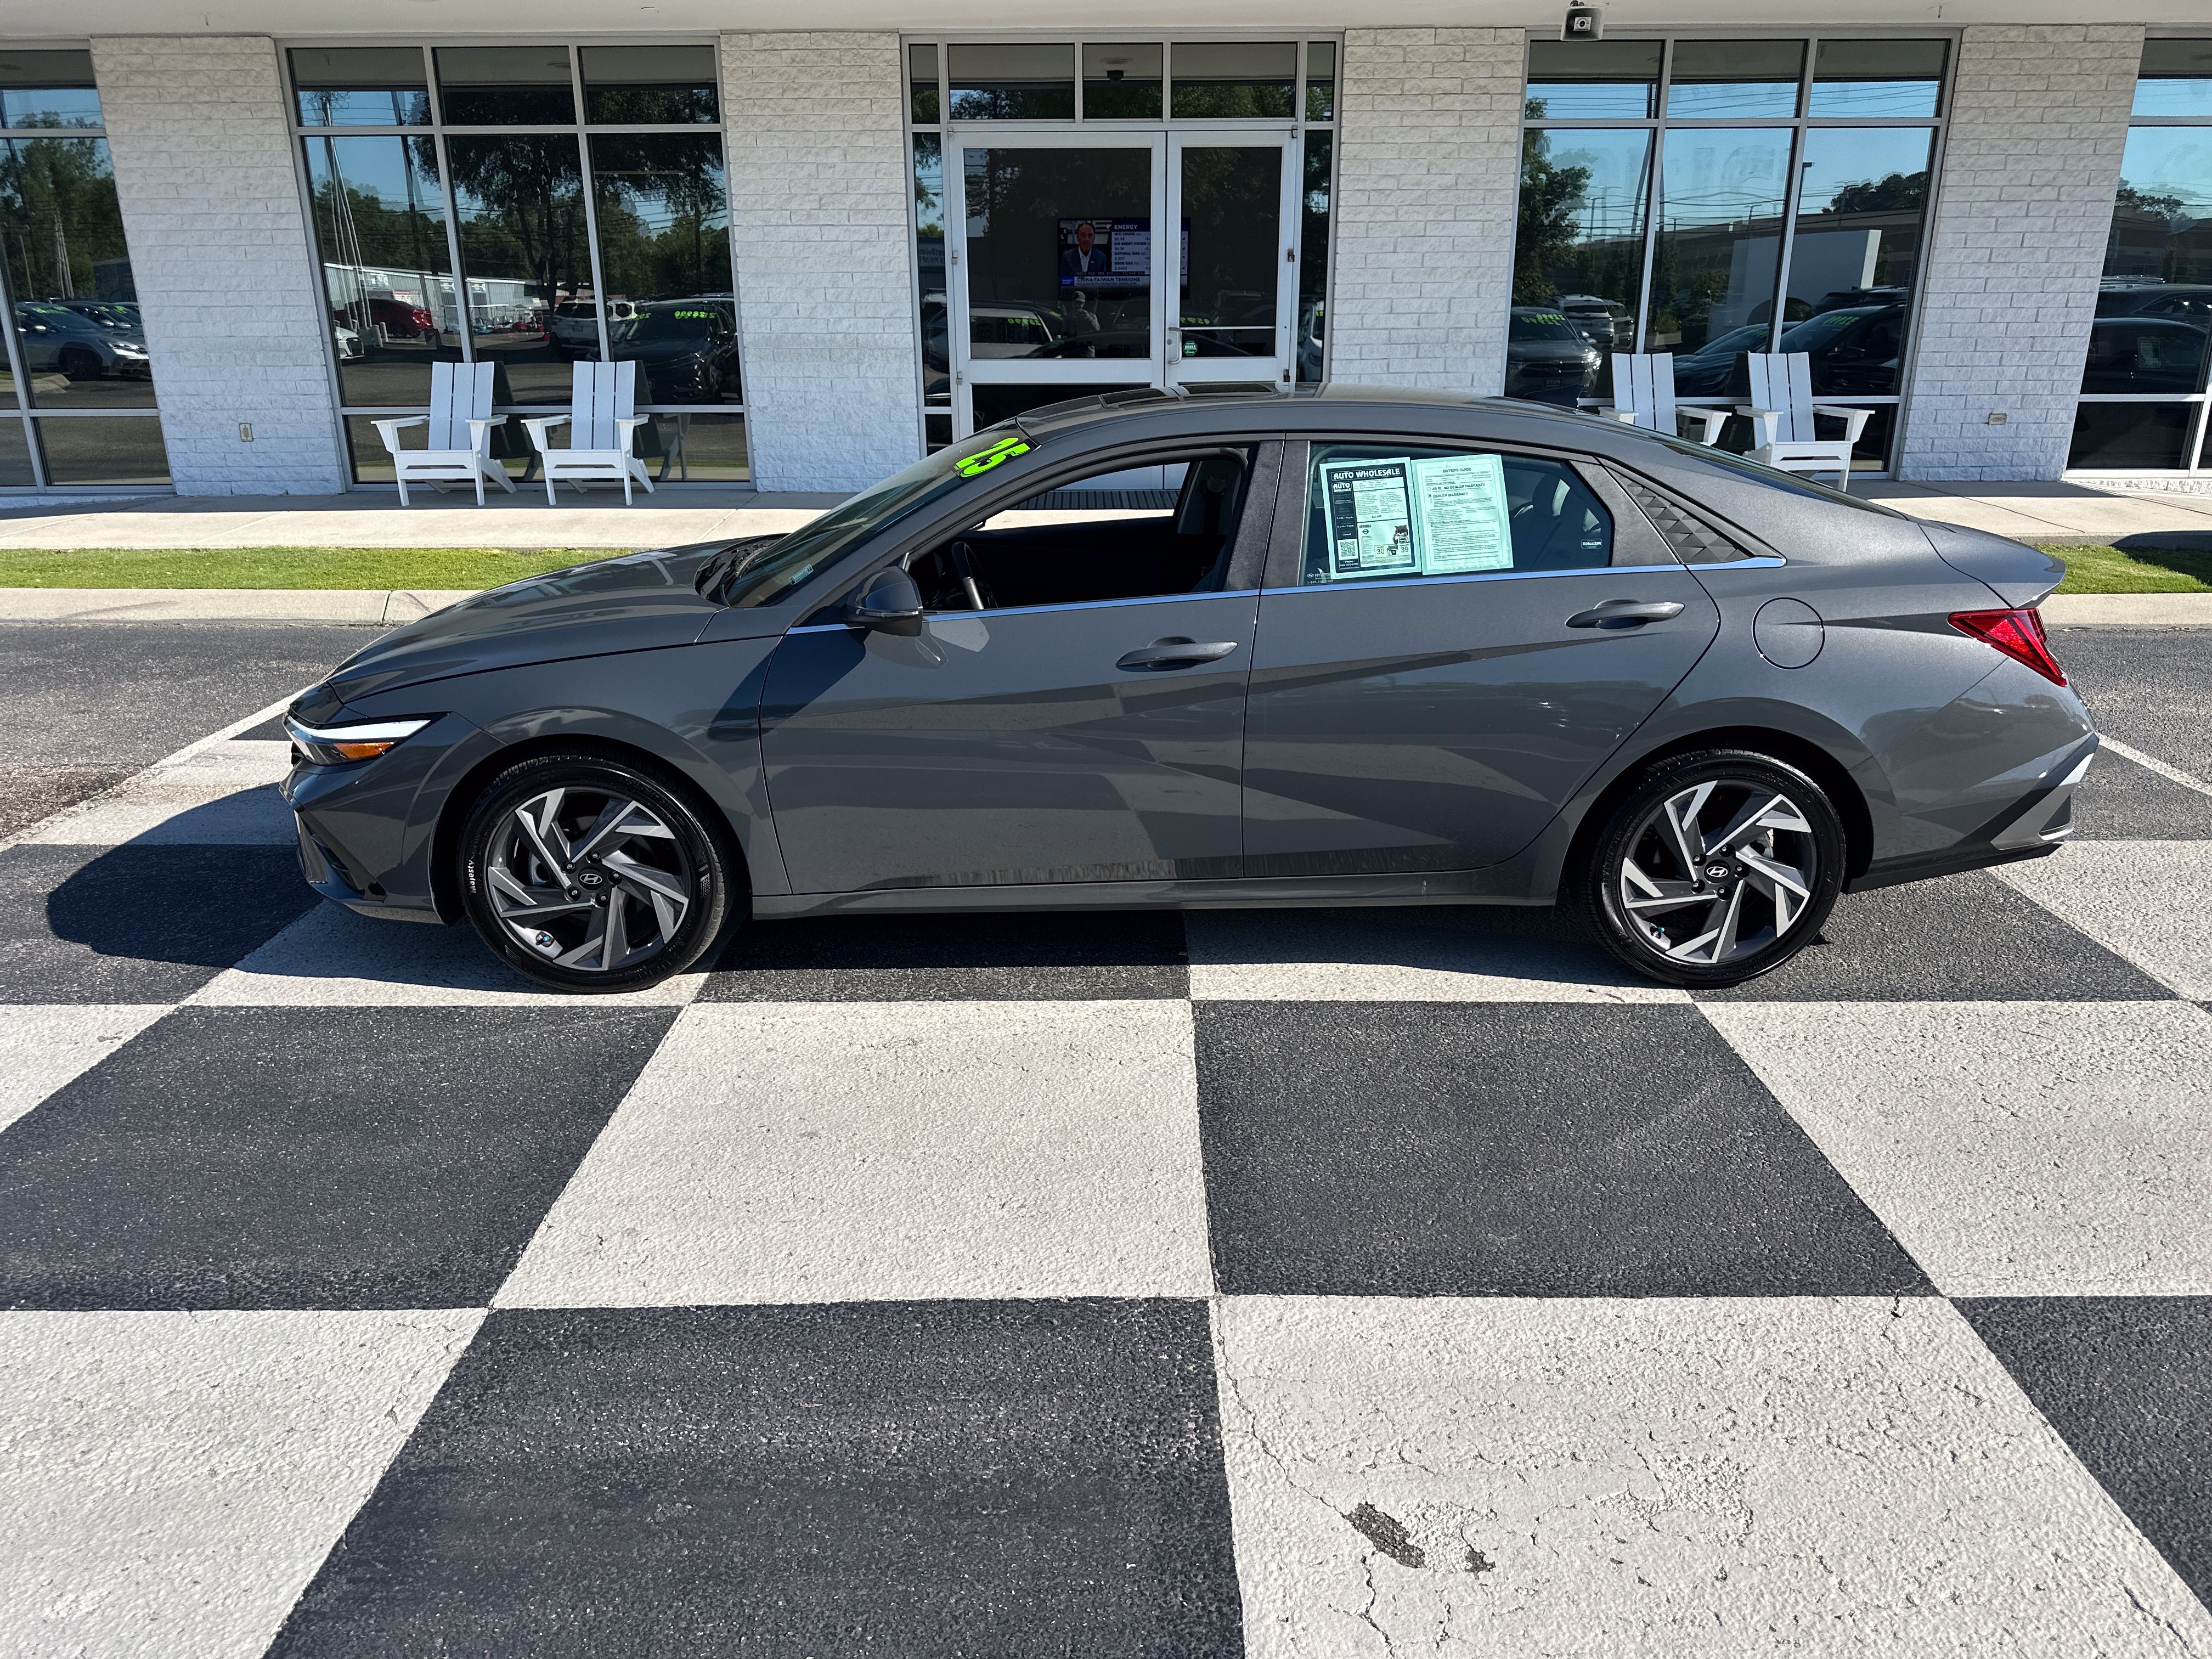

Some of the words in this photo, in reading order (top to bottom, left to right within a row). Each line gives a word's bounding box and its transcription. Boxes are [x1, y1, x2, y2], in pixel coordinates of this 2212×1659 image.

[1333, 471, 1354, 480] AUTO
[1355, 468, 1401, 478] WHOLESALE
[468, 860, 477, 893] Majesty
